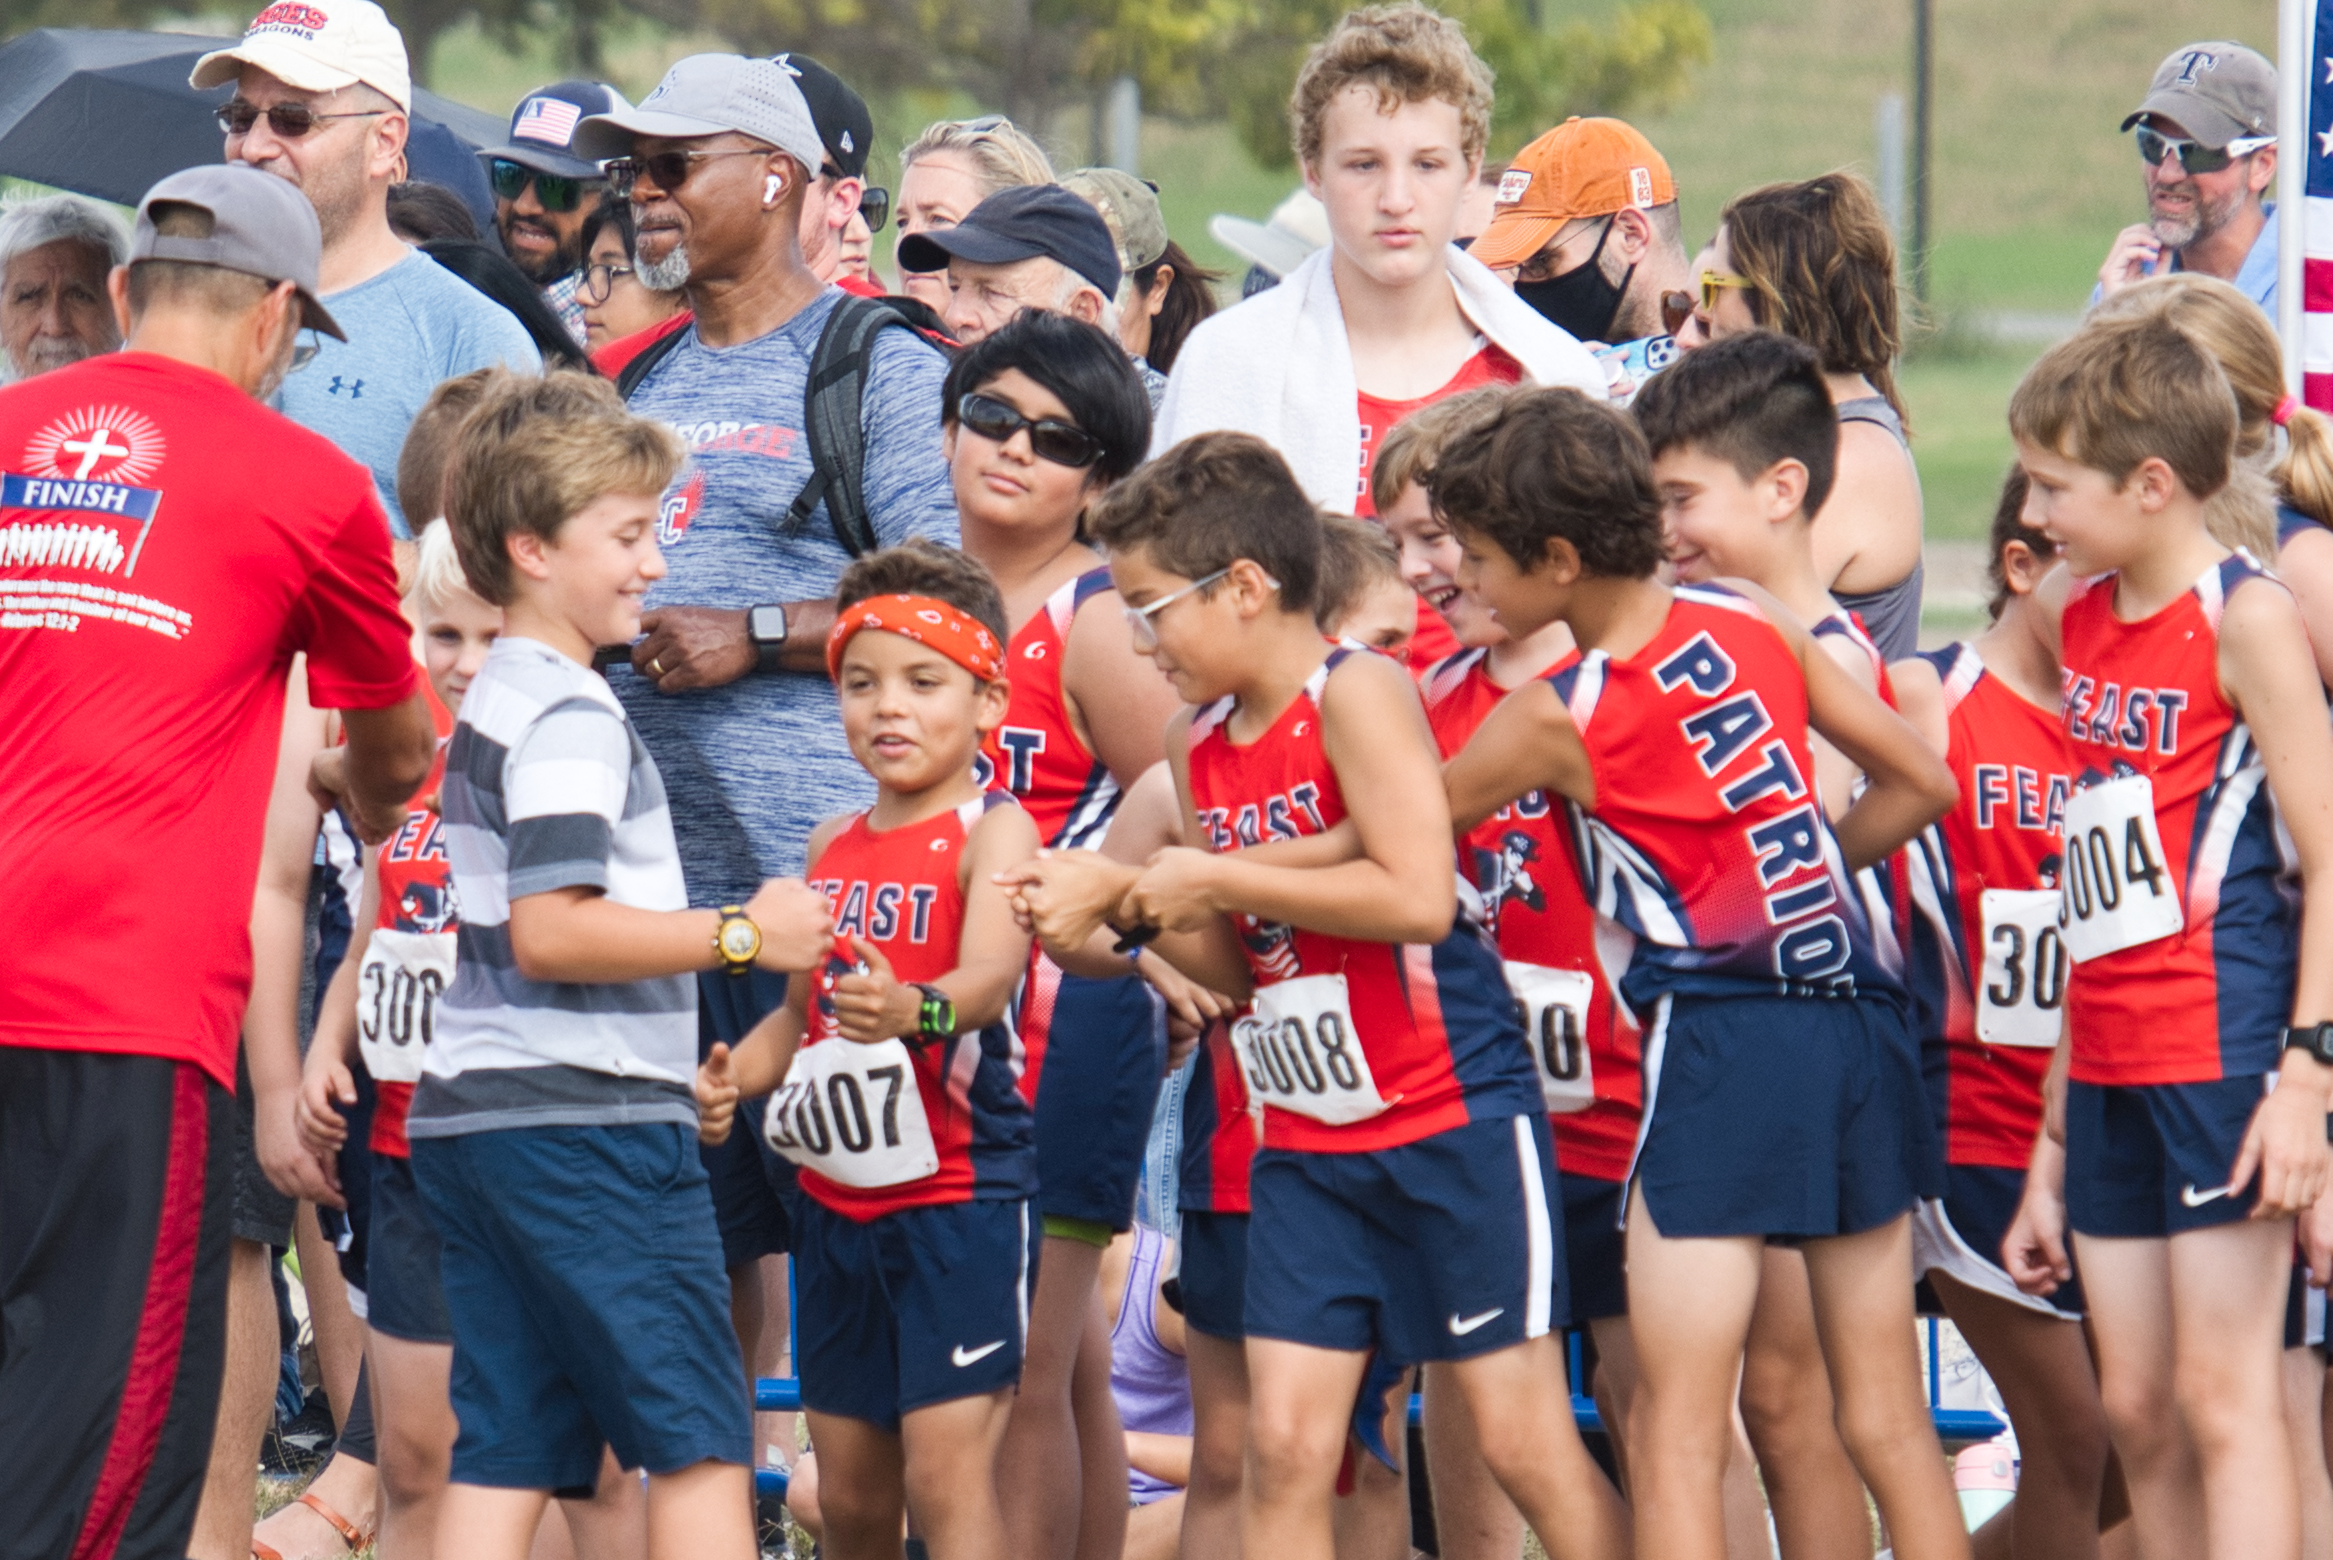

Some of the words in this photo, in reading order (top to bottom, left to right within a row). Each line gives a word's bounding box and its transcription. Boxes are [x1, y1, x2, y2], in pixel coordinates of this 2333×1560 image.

[2176, 51, 2219, 88] T
[23, 480, 130, 512] FINISH
[1651, 630, 1855, 997] PATRIO
[811, 879, 937, 943] EAST
[2058, 815, 2167, 929] 004
[770, 1064, 906, 1156] 3007
